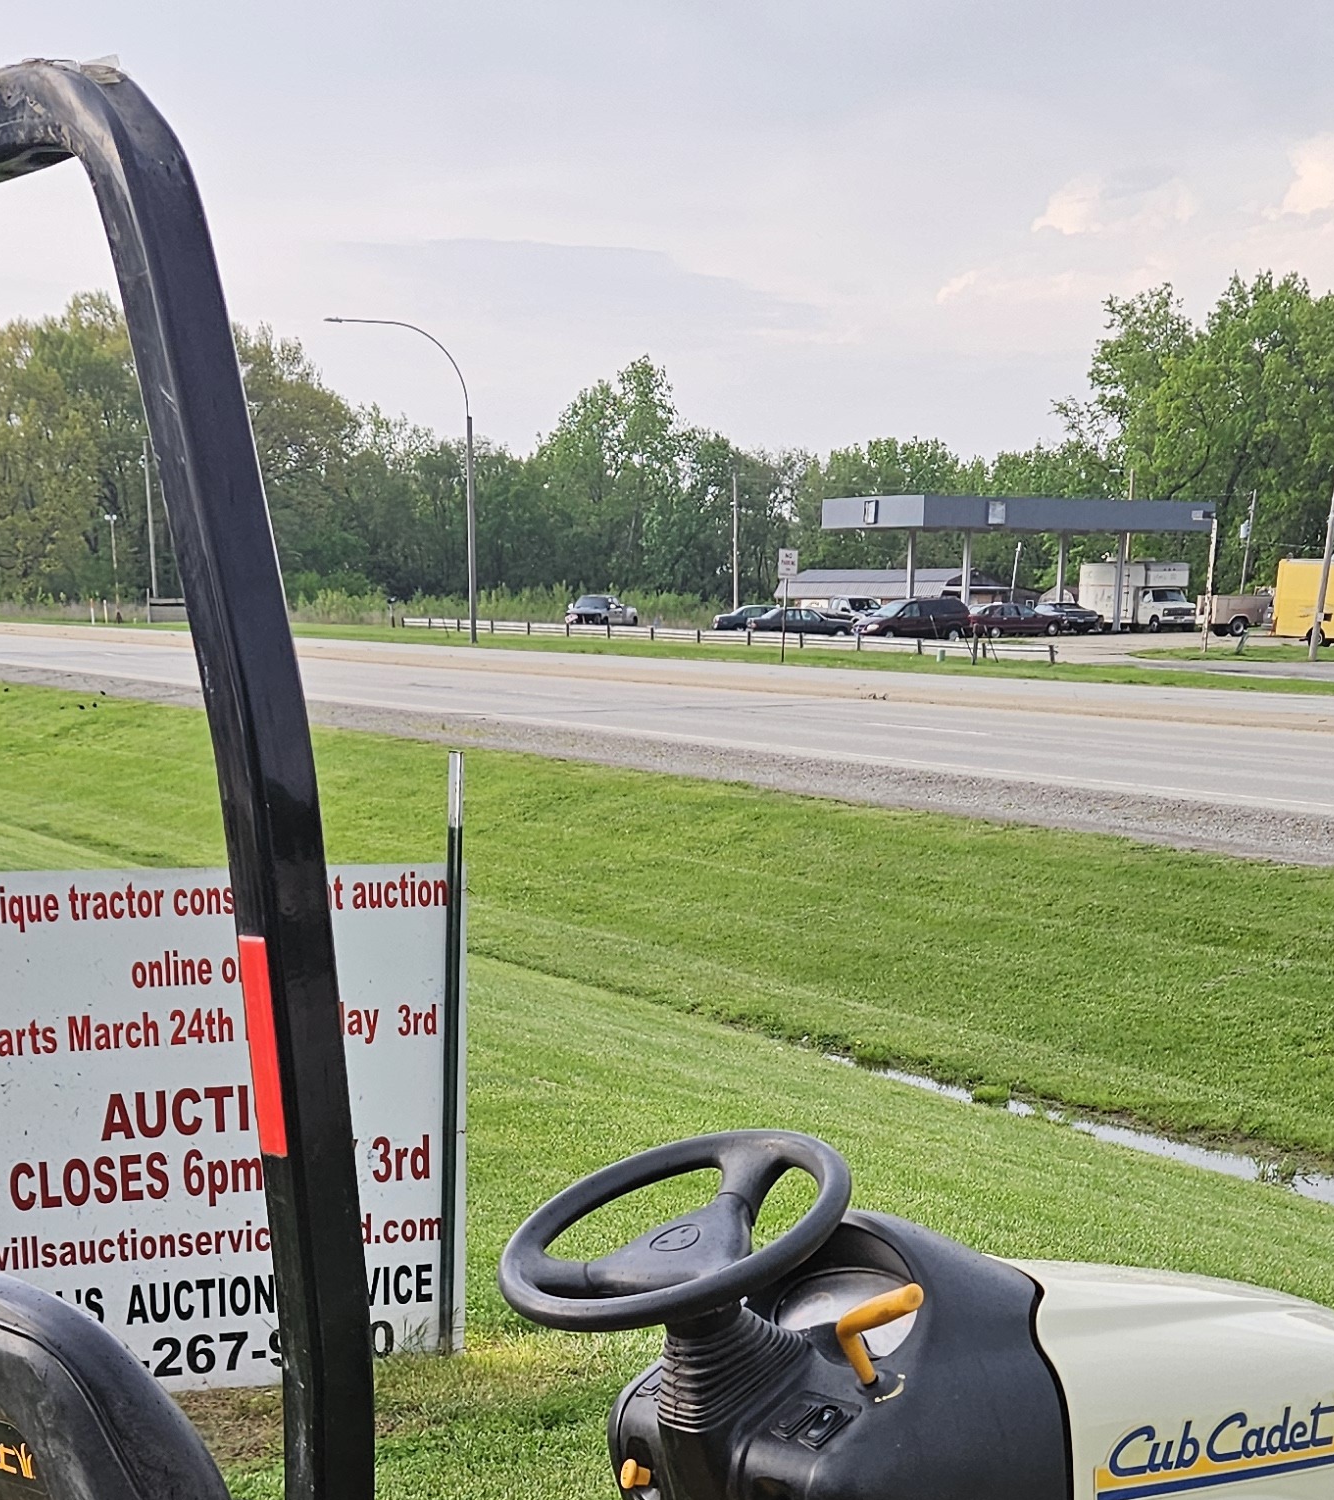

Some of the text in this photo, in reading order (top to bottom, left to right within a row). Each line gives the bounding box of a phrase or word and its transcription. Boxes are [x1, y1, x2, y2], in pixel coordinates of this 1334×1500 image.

[68, 882, 164, 921] tractor
[352, 873, 447, 910] auction
[132, 950, 212, 989] online
[68, 1012, 159, 1052] March
[169, 1007, 234, 1046] 24th
[397, 1003, 438, 1038] 3rd
[9, 1135, 431, 1211] CLOSES 6pm 3rd
[1109, 1420, 1200, 1477] Cub
